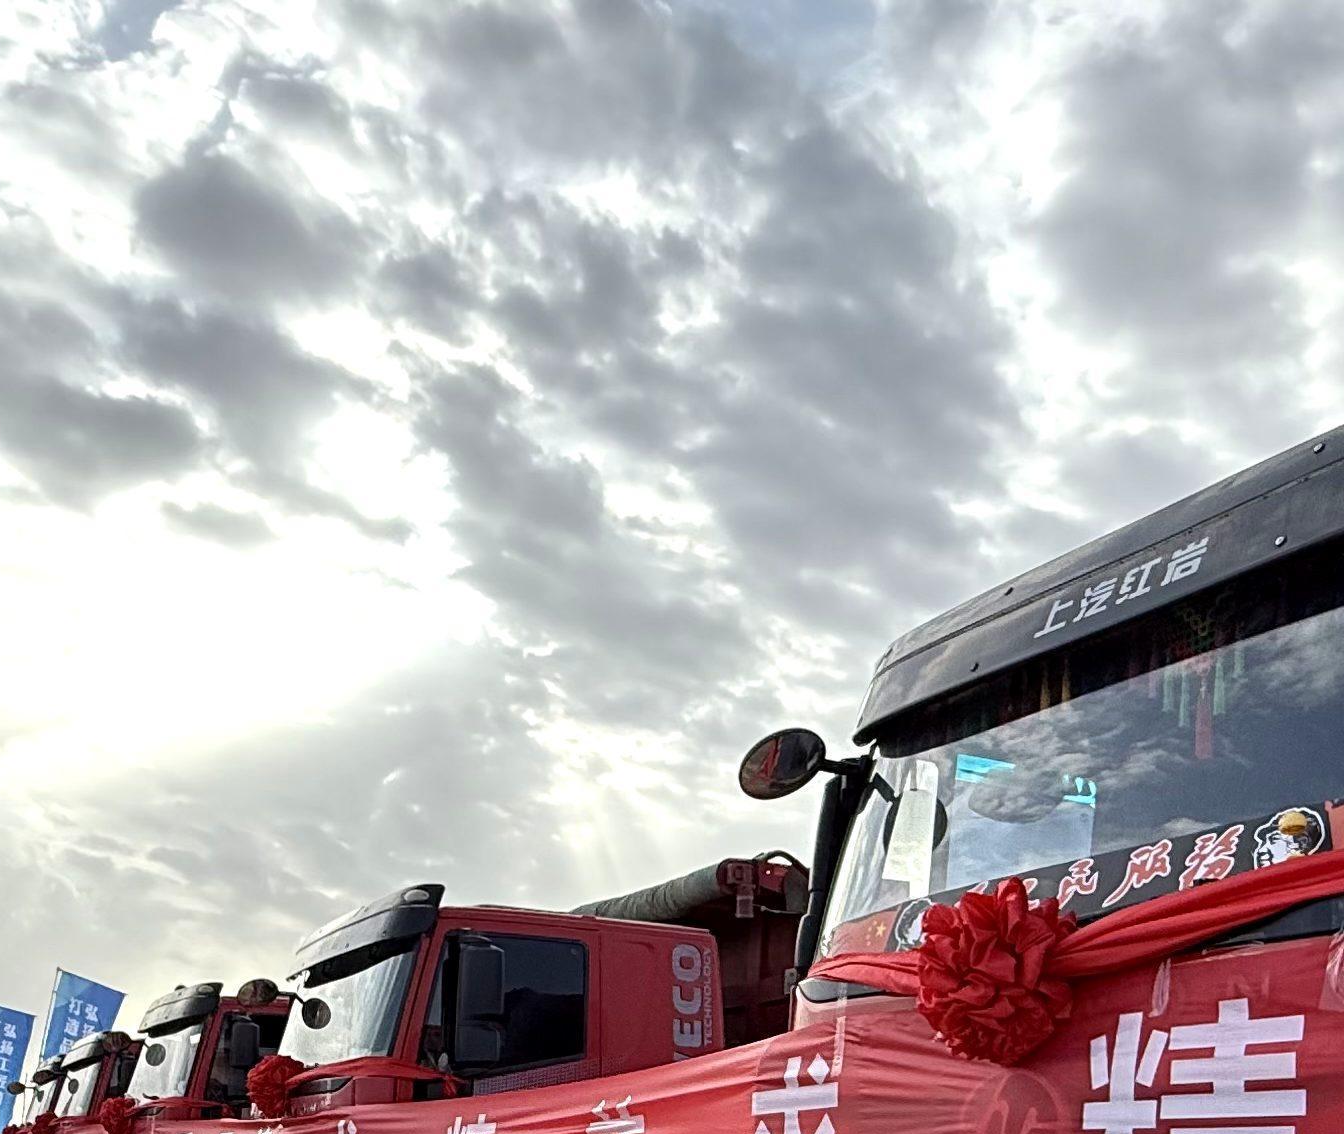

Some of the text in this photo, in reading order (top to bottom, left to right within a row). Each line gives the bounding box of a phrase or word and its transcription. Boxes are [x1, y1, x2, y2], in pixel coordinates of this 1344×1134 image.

[1033, 536, 1210, 638] 上汽红岩
[672, 943, 703, 1061] ECO
